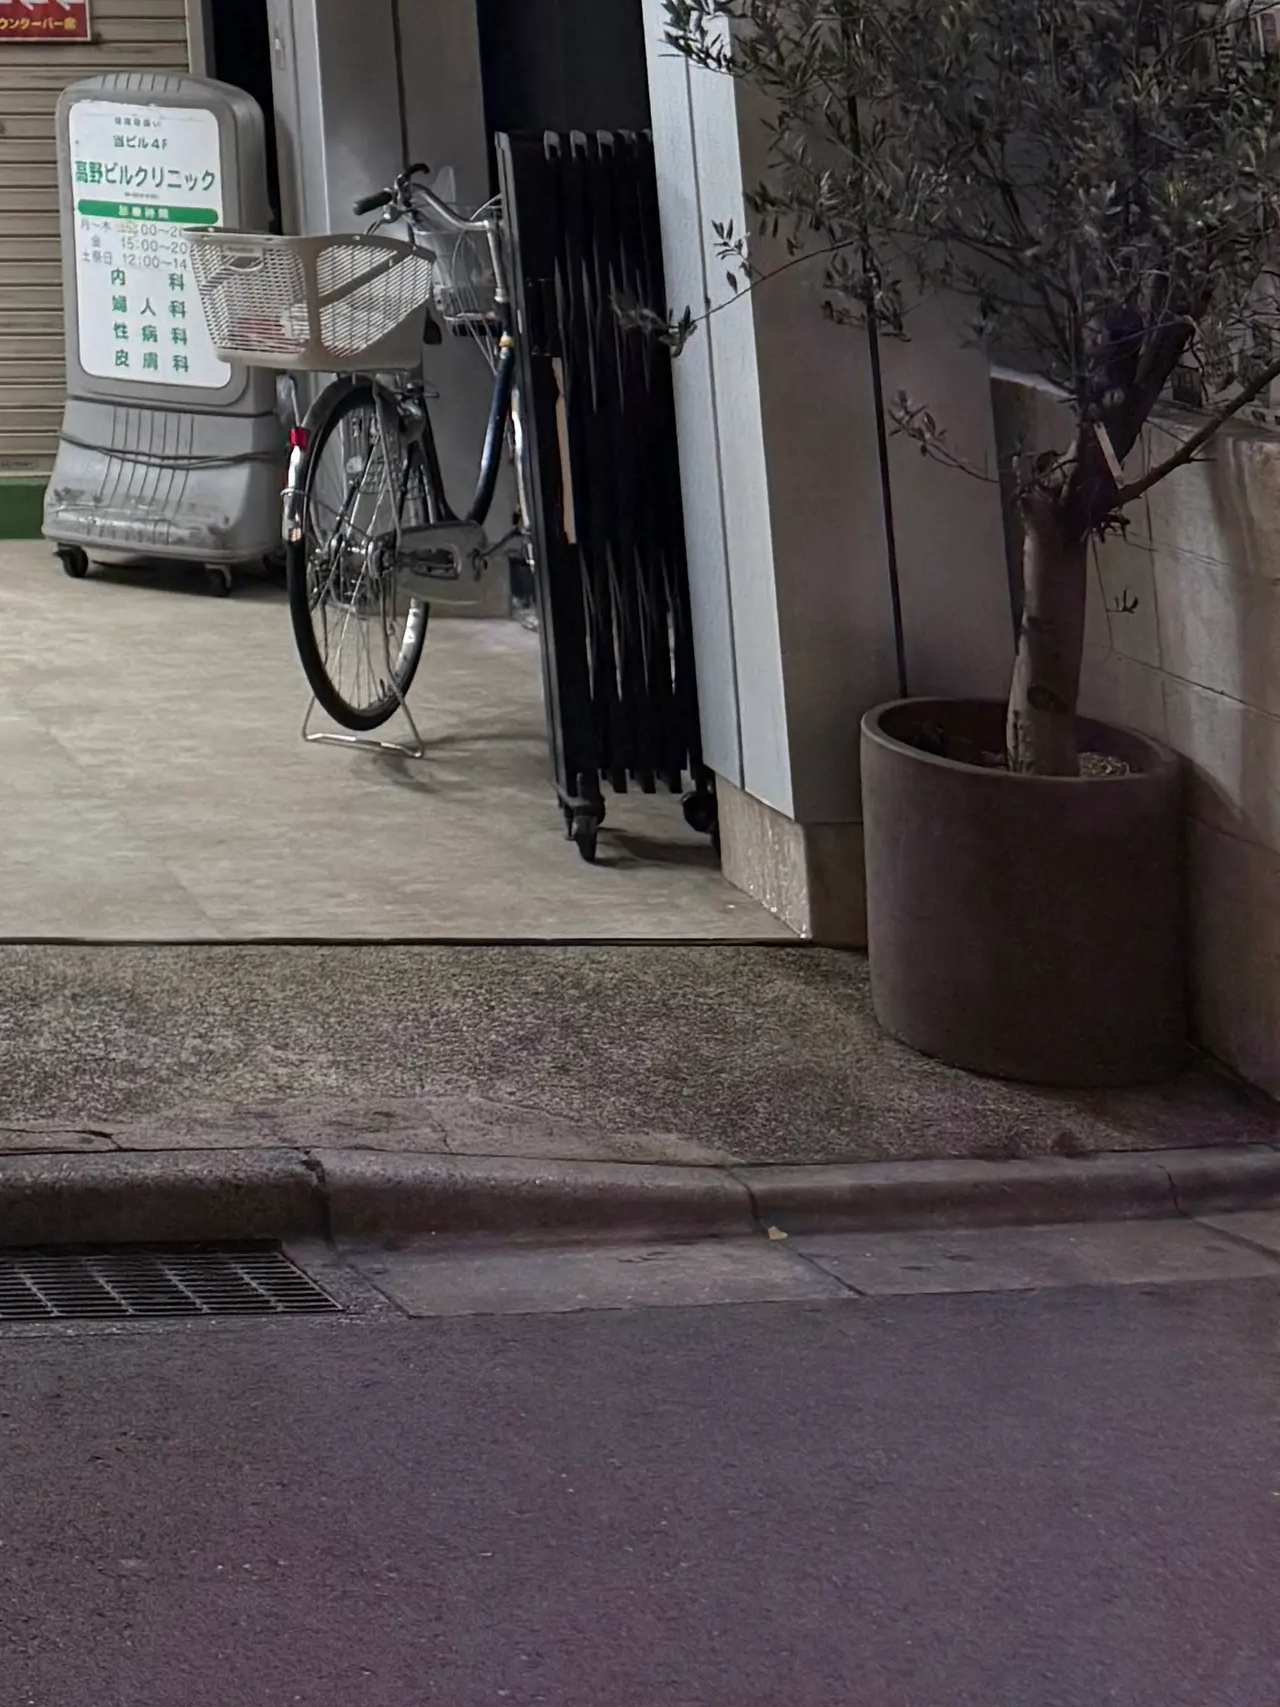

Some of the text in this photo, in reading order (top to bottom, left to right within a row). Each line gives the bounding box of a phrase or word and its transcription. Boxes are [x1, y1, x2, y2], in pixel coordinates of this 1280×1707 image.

[74, 160, 216, 192] 高野ビルクリニック
[112, 321, 188, 346] 性病科
